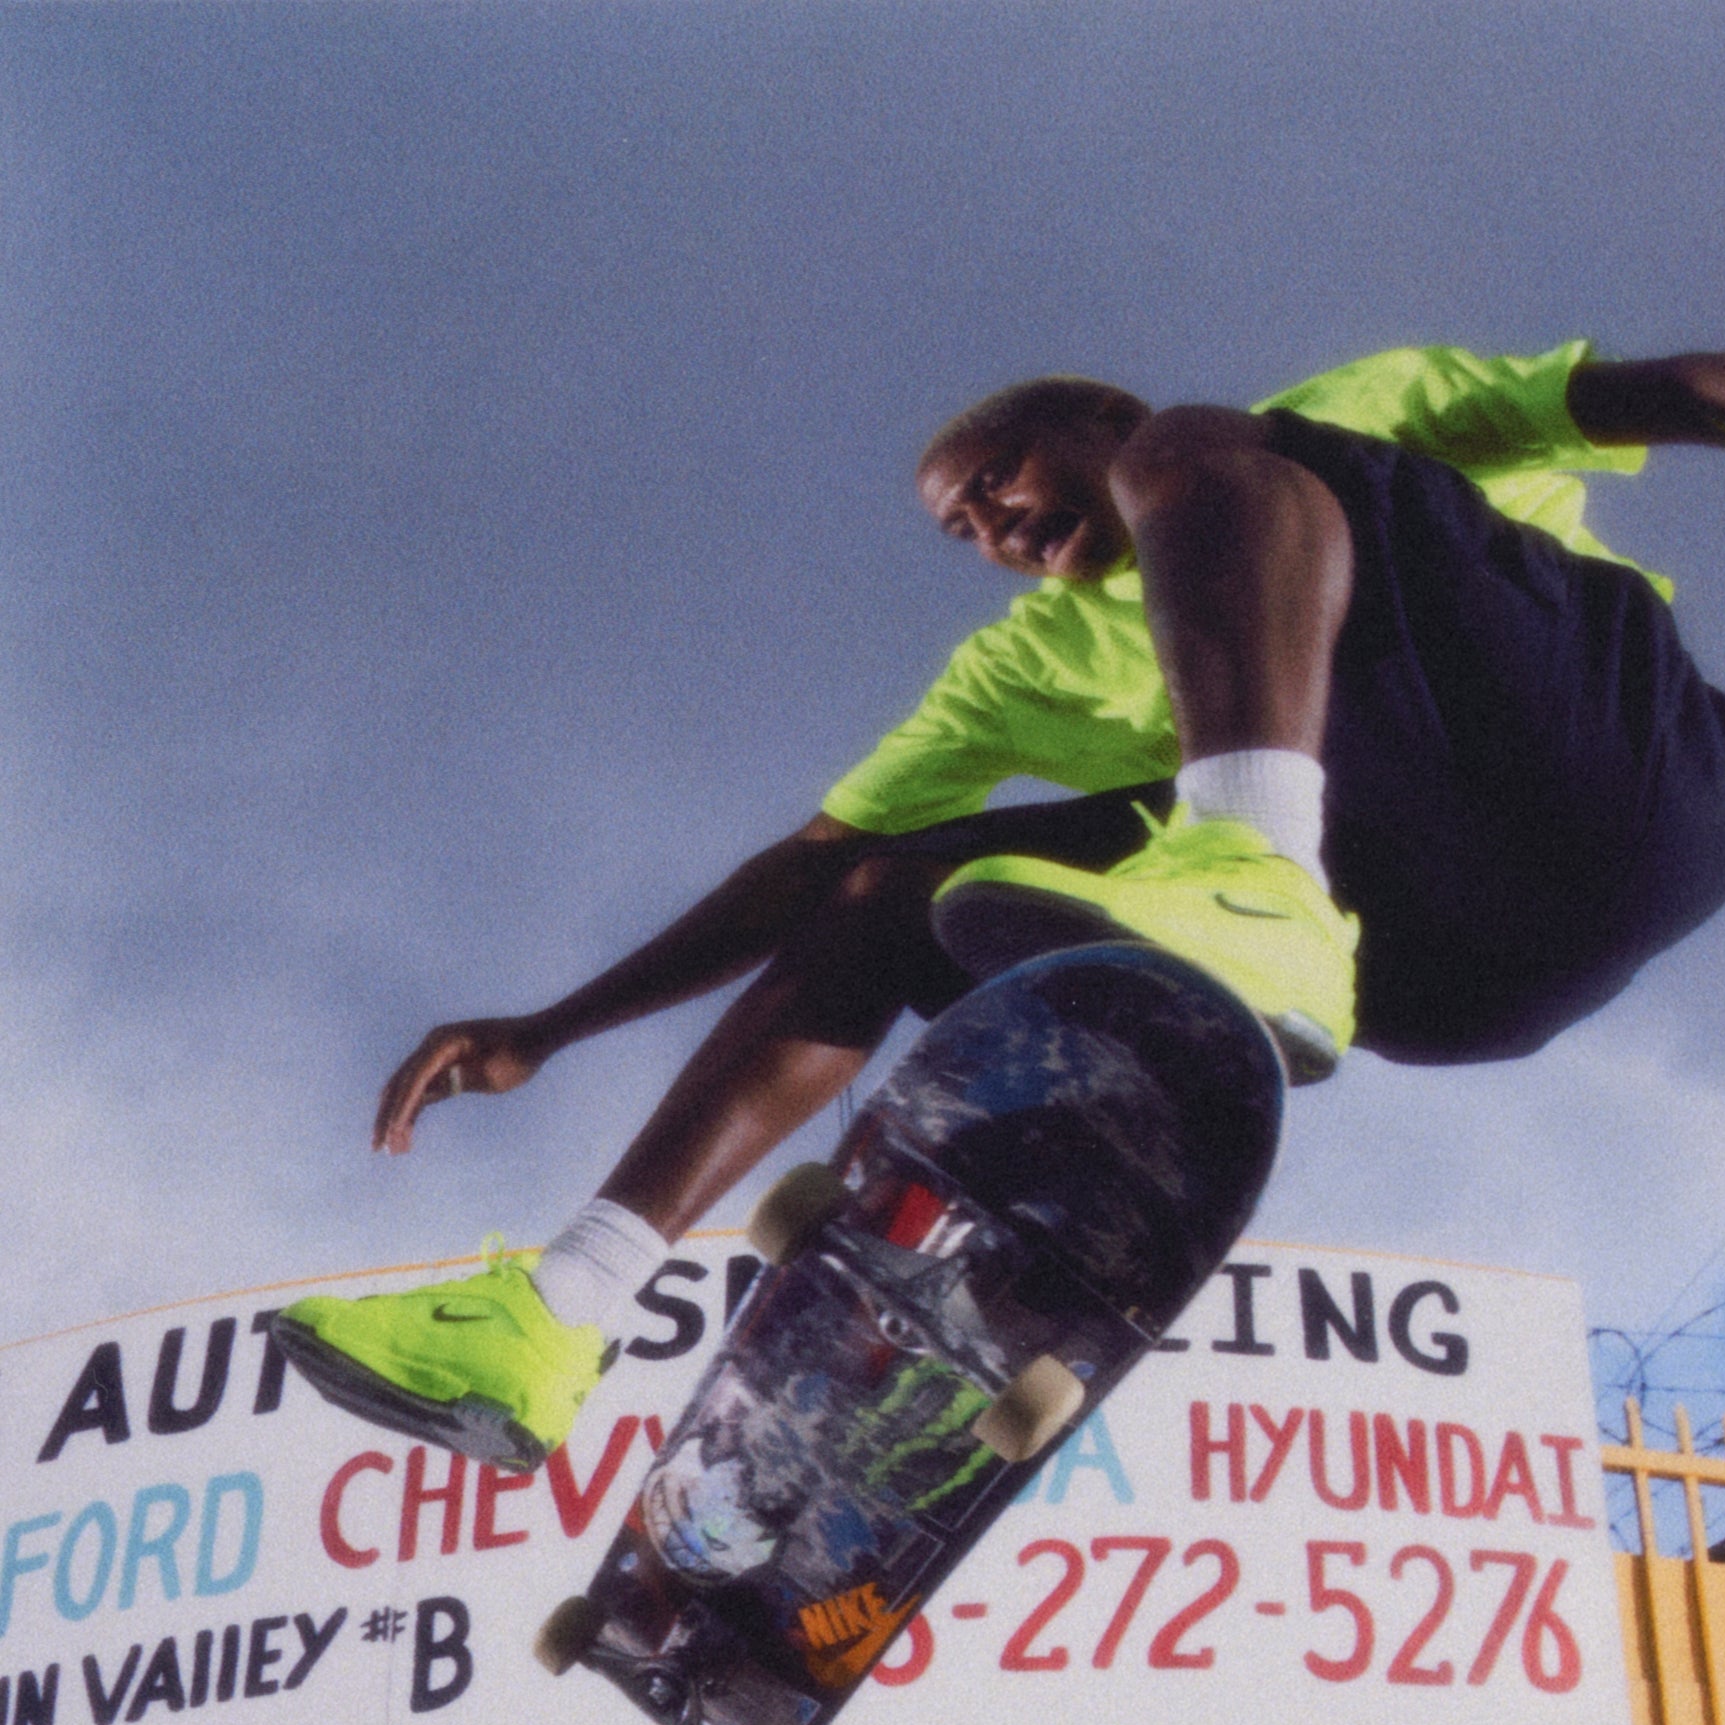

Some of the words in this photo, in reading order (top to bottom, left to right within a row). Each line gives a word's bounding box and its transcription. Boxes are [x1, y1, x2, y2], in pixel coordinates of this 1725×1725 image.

[36, 1309, 293, 1464] AUT
[0, 1470, 265, 1638] FORD
[320, 1414, 665, 1569] CHEV
[1188, 1401, 1597, 1531] HYUNDAI
